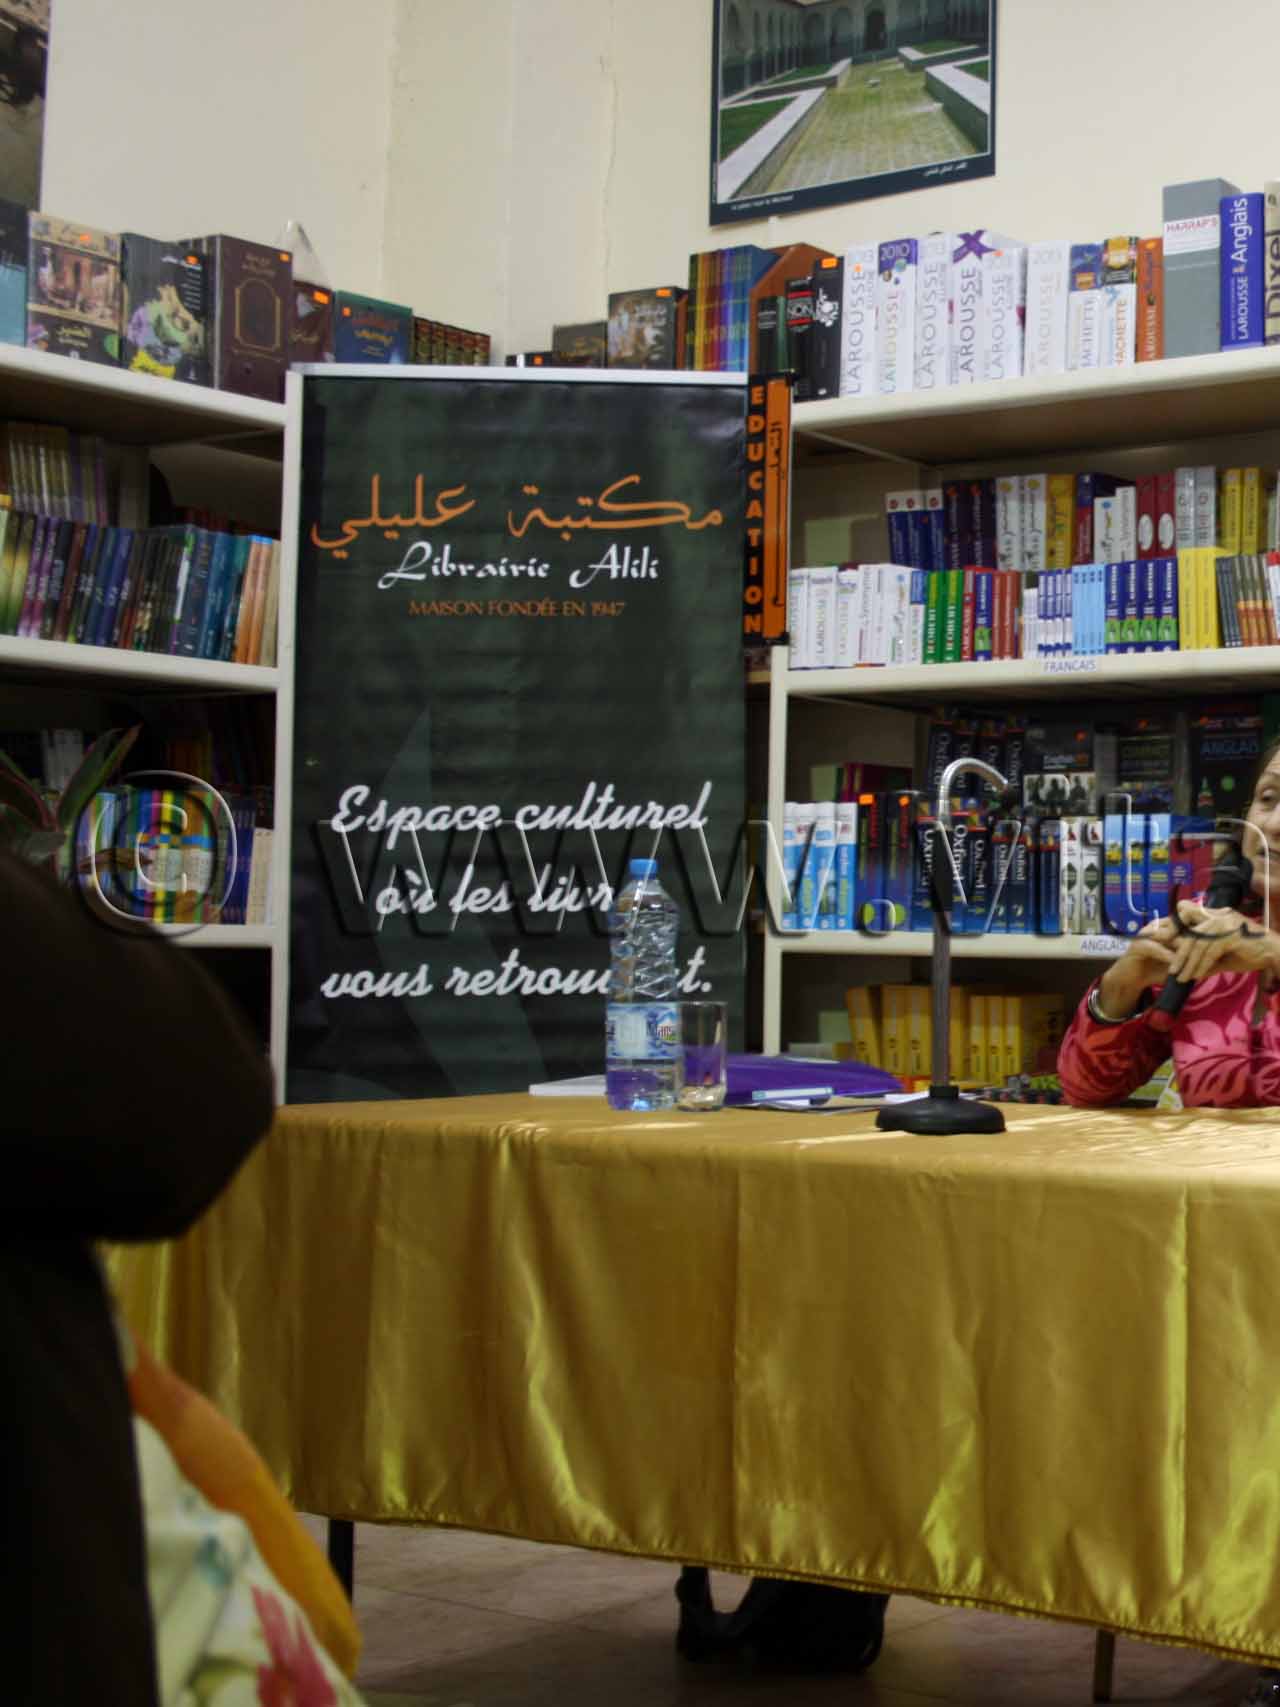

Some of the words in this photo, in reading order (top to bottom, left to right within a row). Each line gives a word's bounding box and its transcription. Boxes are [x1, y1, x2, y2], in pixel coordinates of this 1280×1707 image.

[1230, 196, 1253, 265] Anglais
[847, 270, 867, 395] LAROUSSE
[917, 260, 939, 390] LAROUSSE
[990, 274, 1006, 381] LAROUSSE
[1238, 274, 1250, 342] LAROUSSE
[310, 472, 477, 559] عليلي
[507, 473, 724, 542] مكتبة
[743, 384, 766, 635] EDUCATION
[376, 540, 551, 590] Librairie
[568, 542, 661, 590] Alili
[408, 600, 483, 617] MAISON
[561, 600, 586, 616] EN
[331, 784, 503, 851] Espace
[514, 780, 714, 832] culturel
[952, 824, 968, 881] Oxford
[375, 868, 438, 915] où
[447, 862, 512, 914] les
[527, 862, 618, 914] livr
[319, 962, 435, 1000] vous
